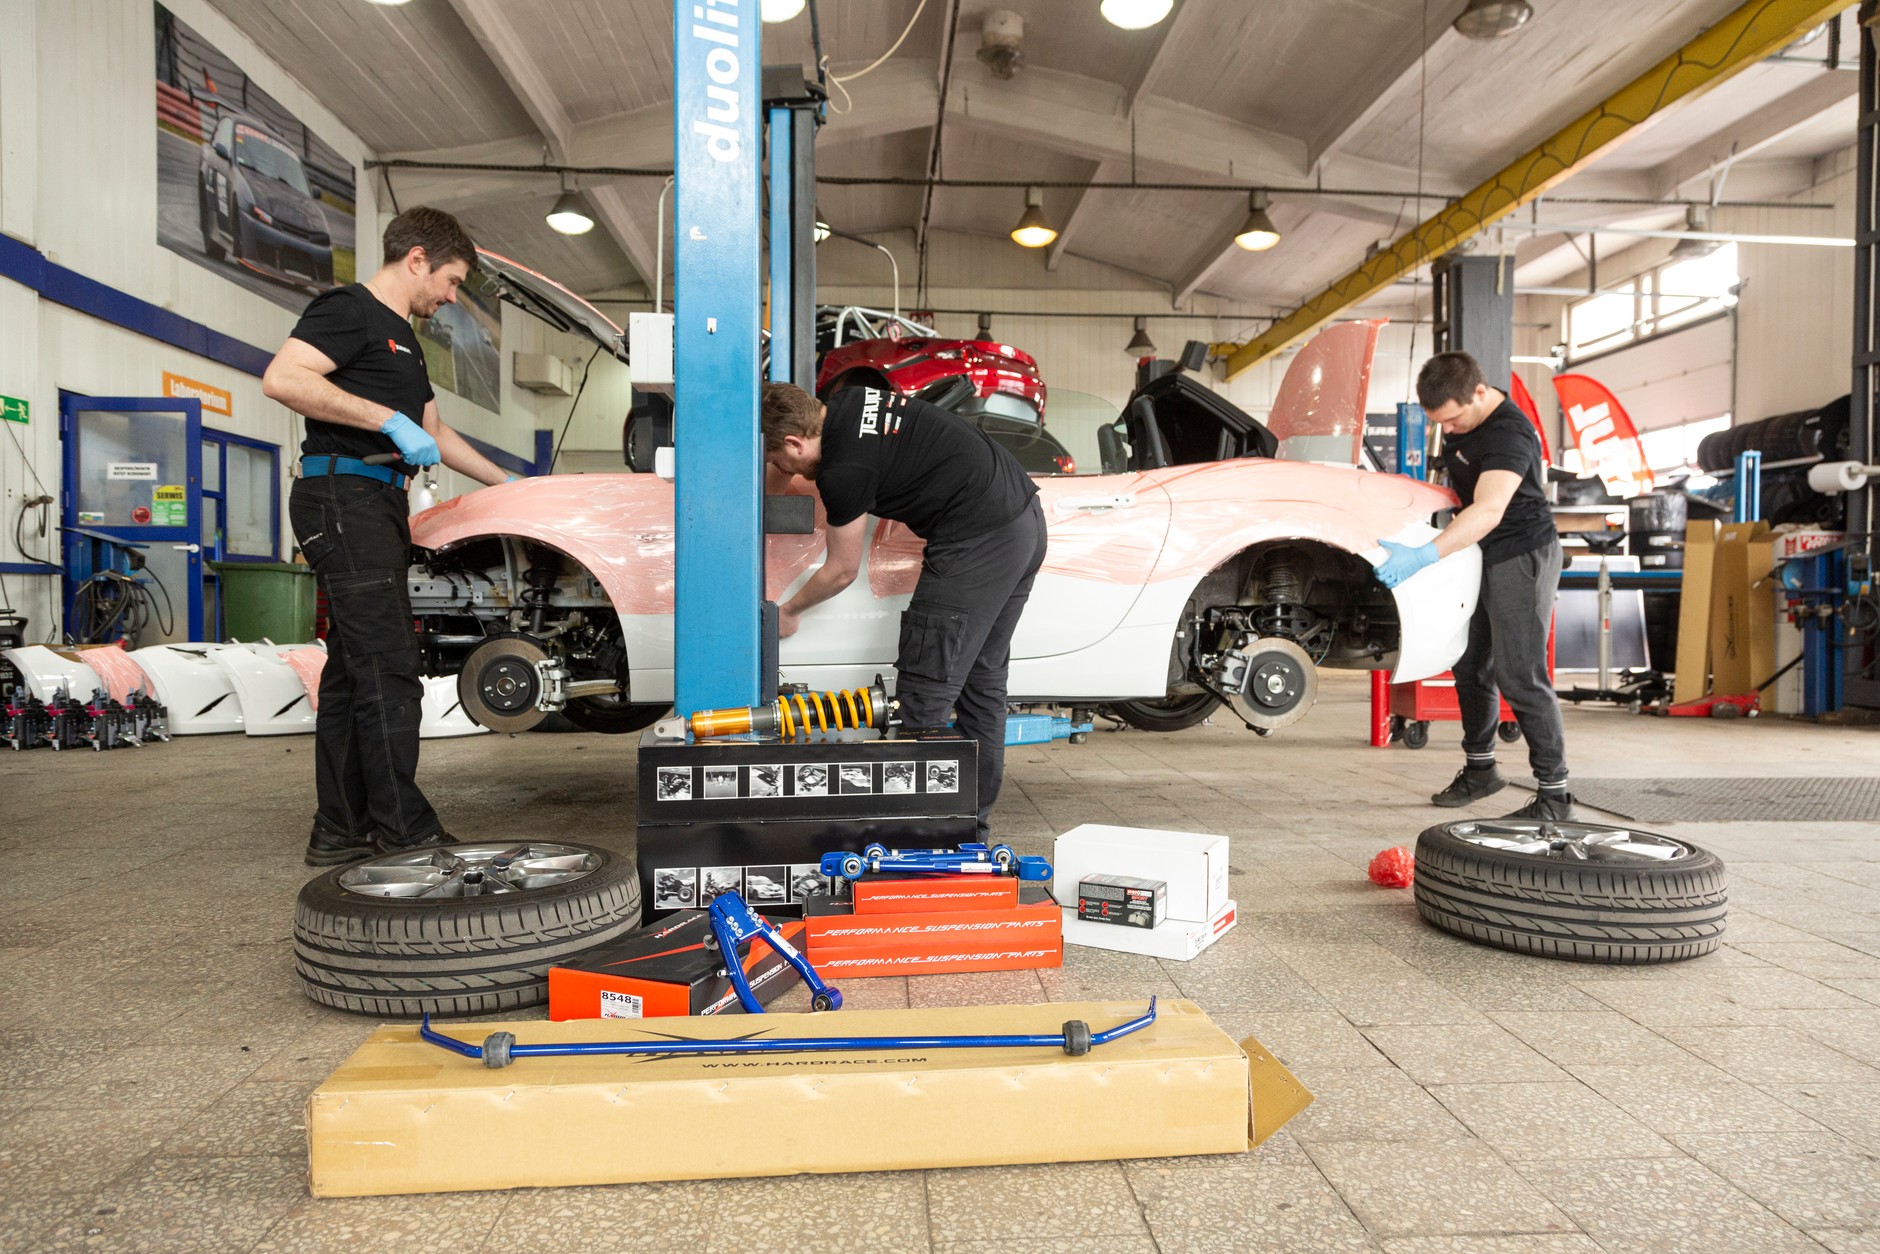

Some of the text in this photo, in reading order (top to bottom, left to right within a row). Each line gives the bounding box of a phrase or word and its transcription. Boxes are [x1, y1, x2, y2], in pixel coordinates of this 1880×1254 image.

[693, 0, 740, 163] duoli
[170, 378, 227, 410] Laboratorium
[825, 926, 920, 936] PERFORMANCE
[924, 922, 1002, 932] SUSPENSION
[827, 957, 921, 967] PERFORMANCE
[926, 953, 1003, 962] SUSPENSION
[602, 992, 632, 1004] 8548
[702, 1057, 928, 1068] WWW.HARDRACE.COM
